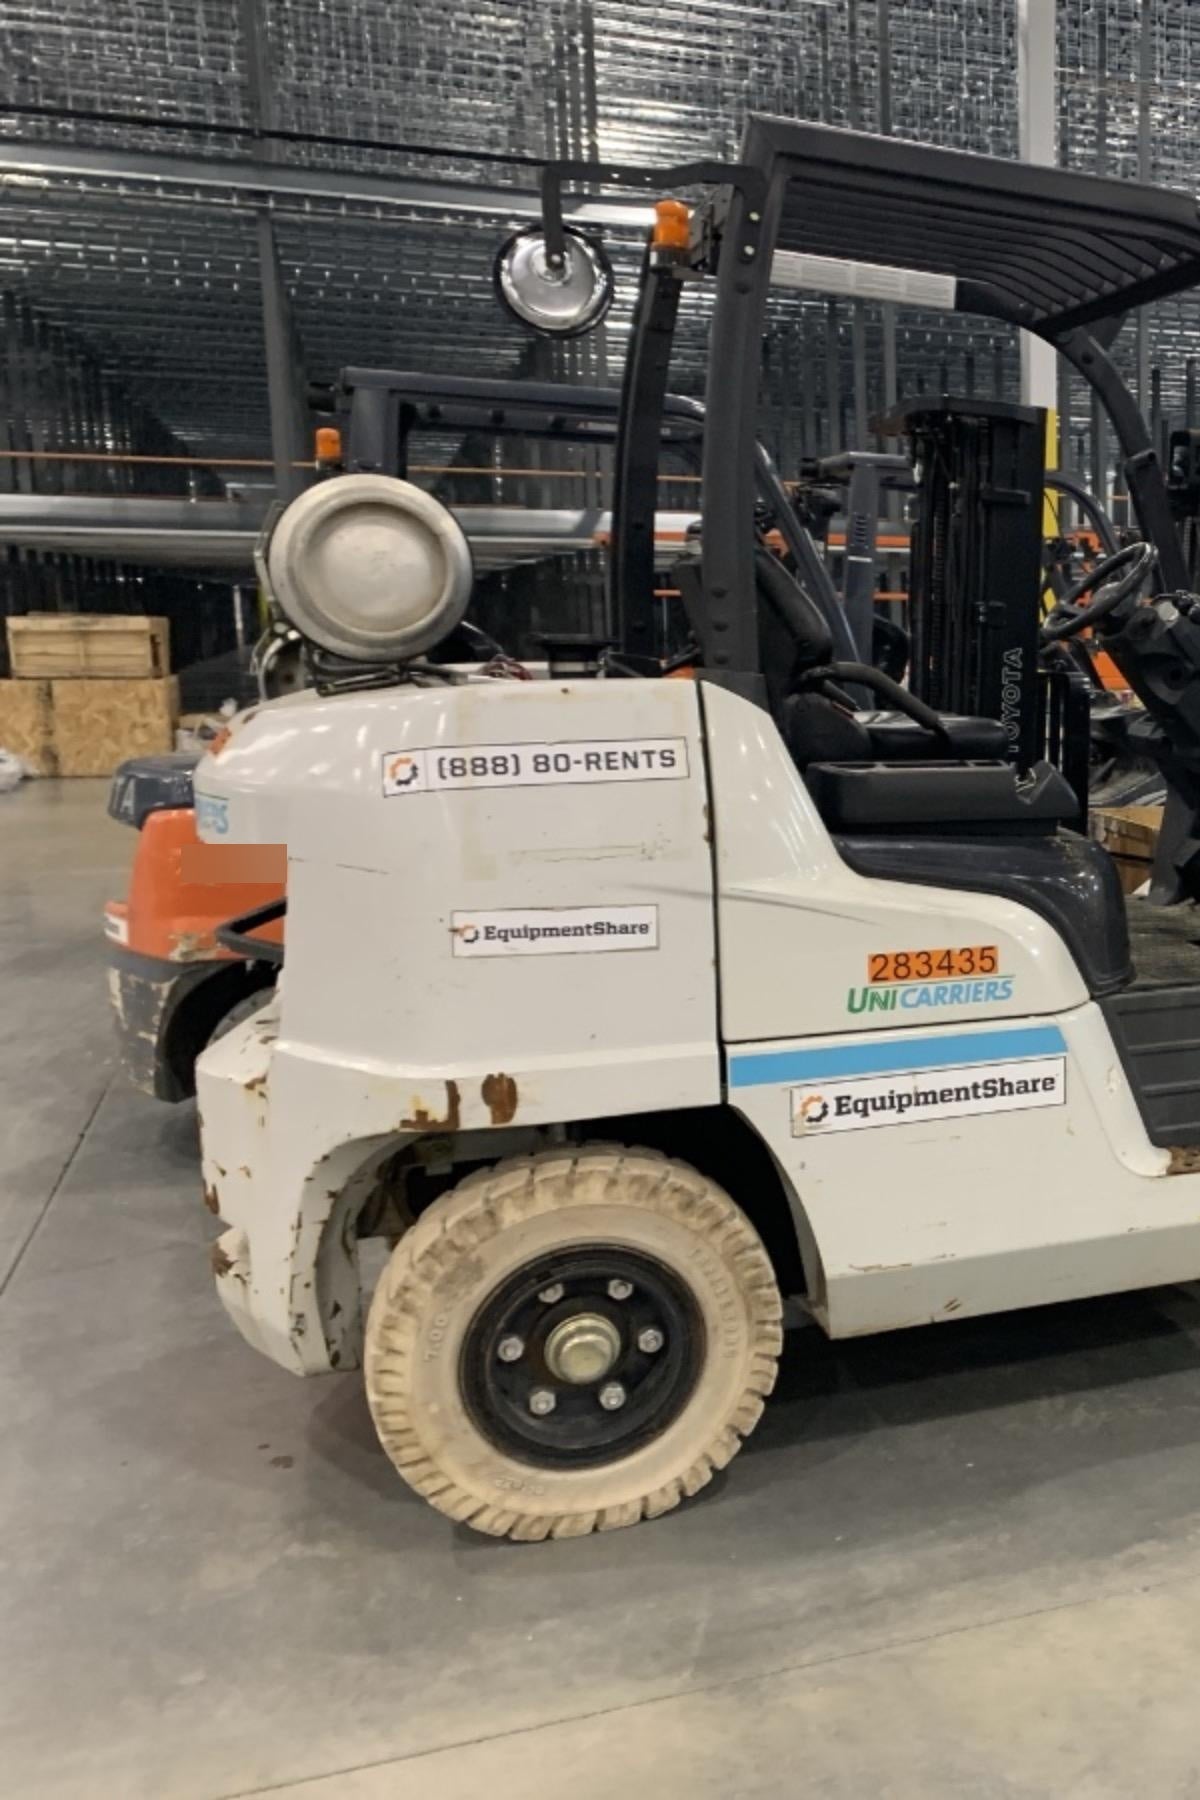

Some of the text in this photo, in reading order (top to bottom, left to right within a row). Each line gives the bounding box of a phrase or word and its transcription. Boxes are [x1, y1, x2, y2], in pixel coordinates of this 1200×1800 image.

[437, 749, 676, 780] (888) 80-RENTS
[483, 920, 650, 942] EquipmentShare
[870, 946, 998, 983] 283435
[834, 1075, 1056, 1119] EquipmentShare
